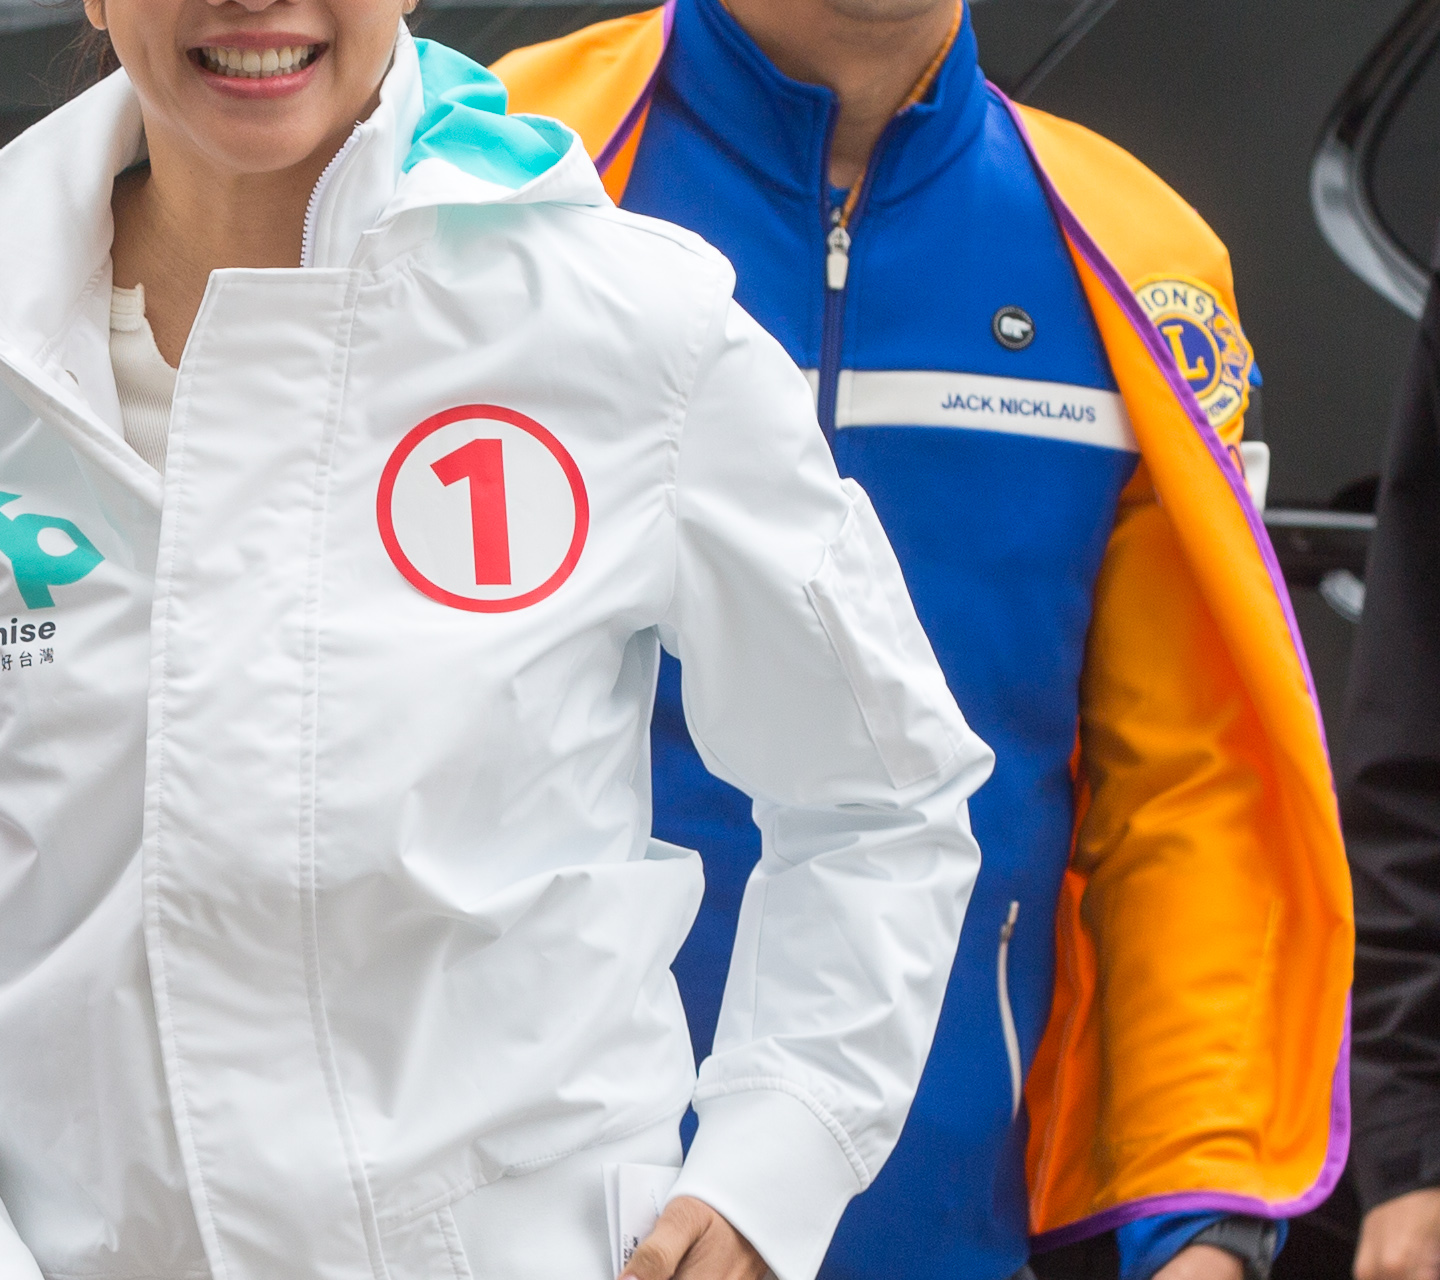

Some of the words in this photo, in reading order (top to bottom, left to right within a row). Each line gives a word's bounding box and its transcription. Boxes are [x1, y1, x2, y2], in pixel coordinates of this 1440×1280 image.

[1142, 287, 1207, 316] IONS
[941, 393, 994, 413] JACK
[1000, 397, 1097, 422] NICKLAUS
[429, 438, 512, 586] 1
